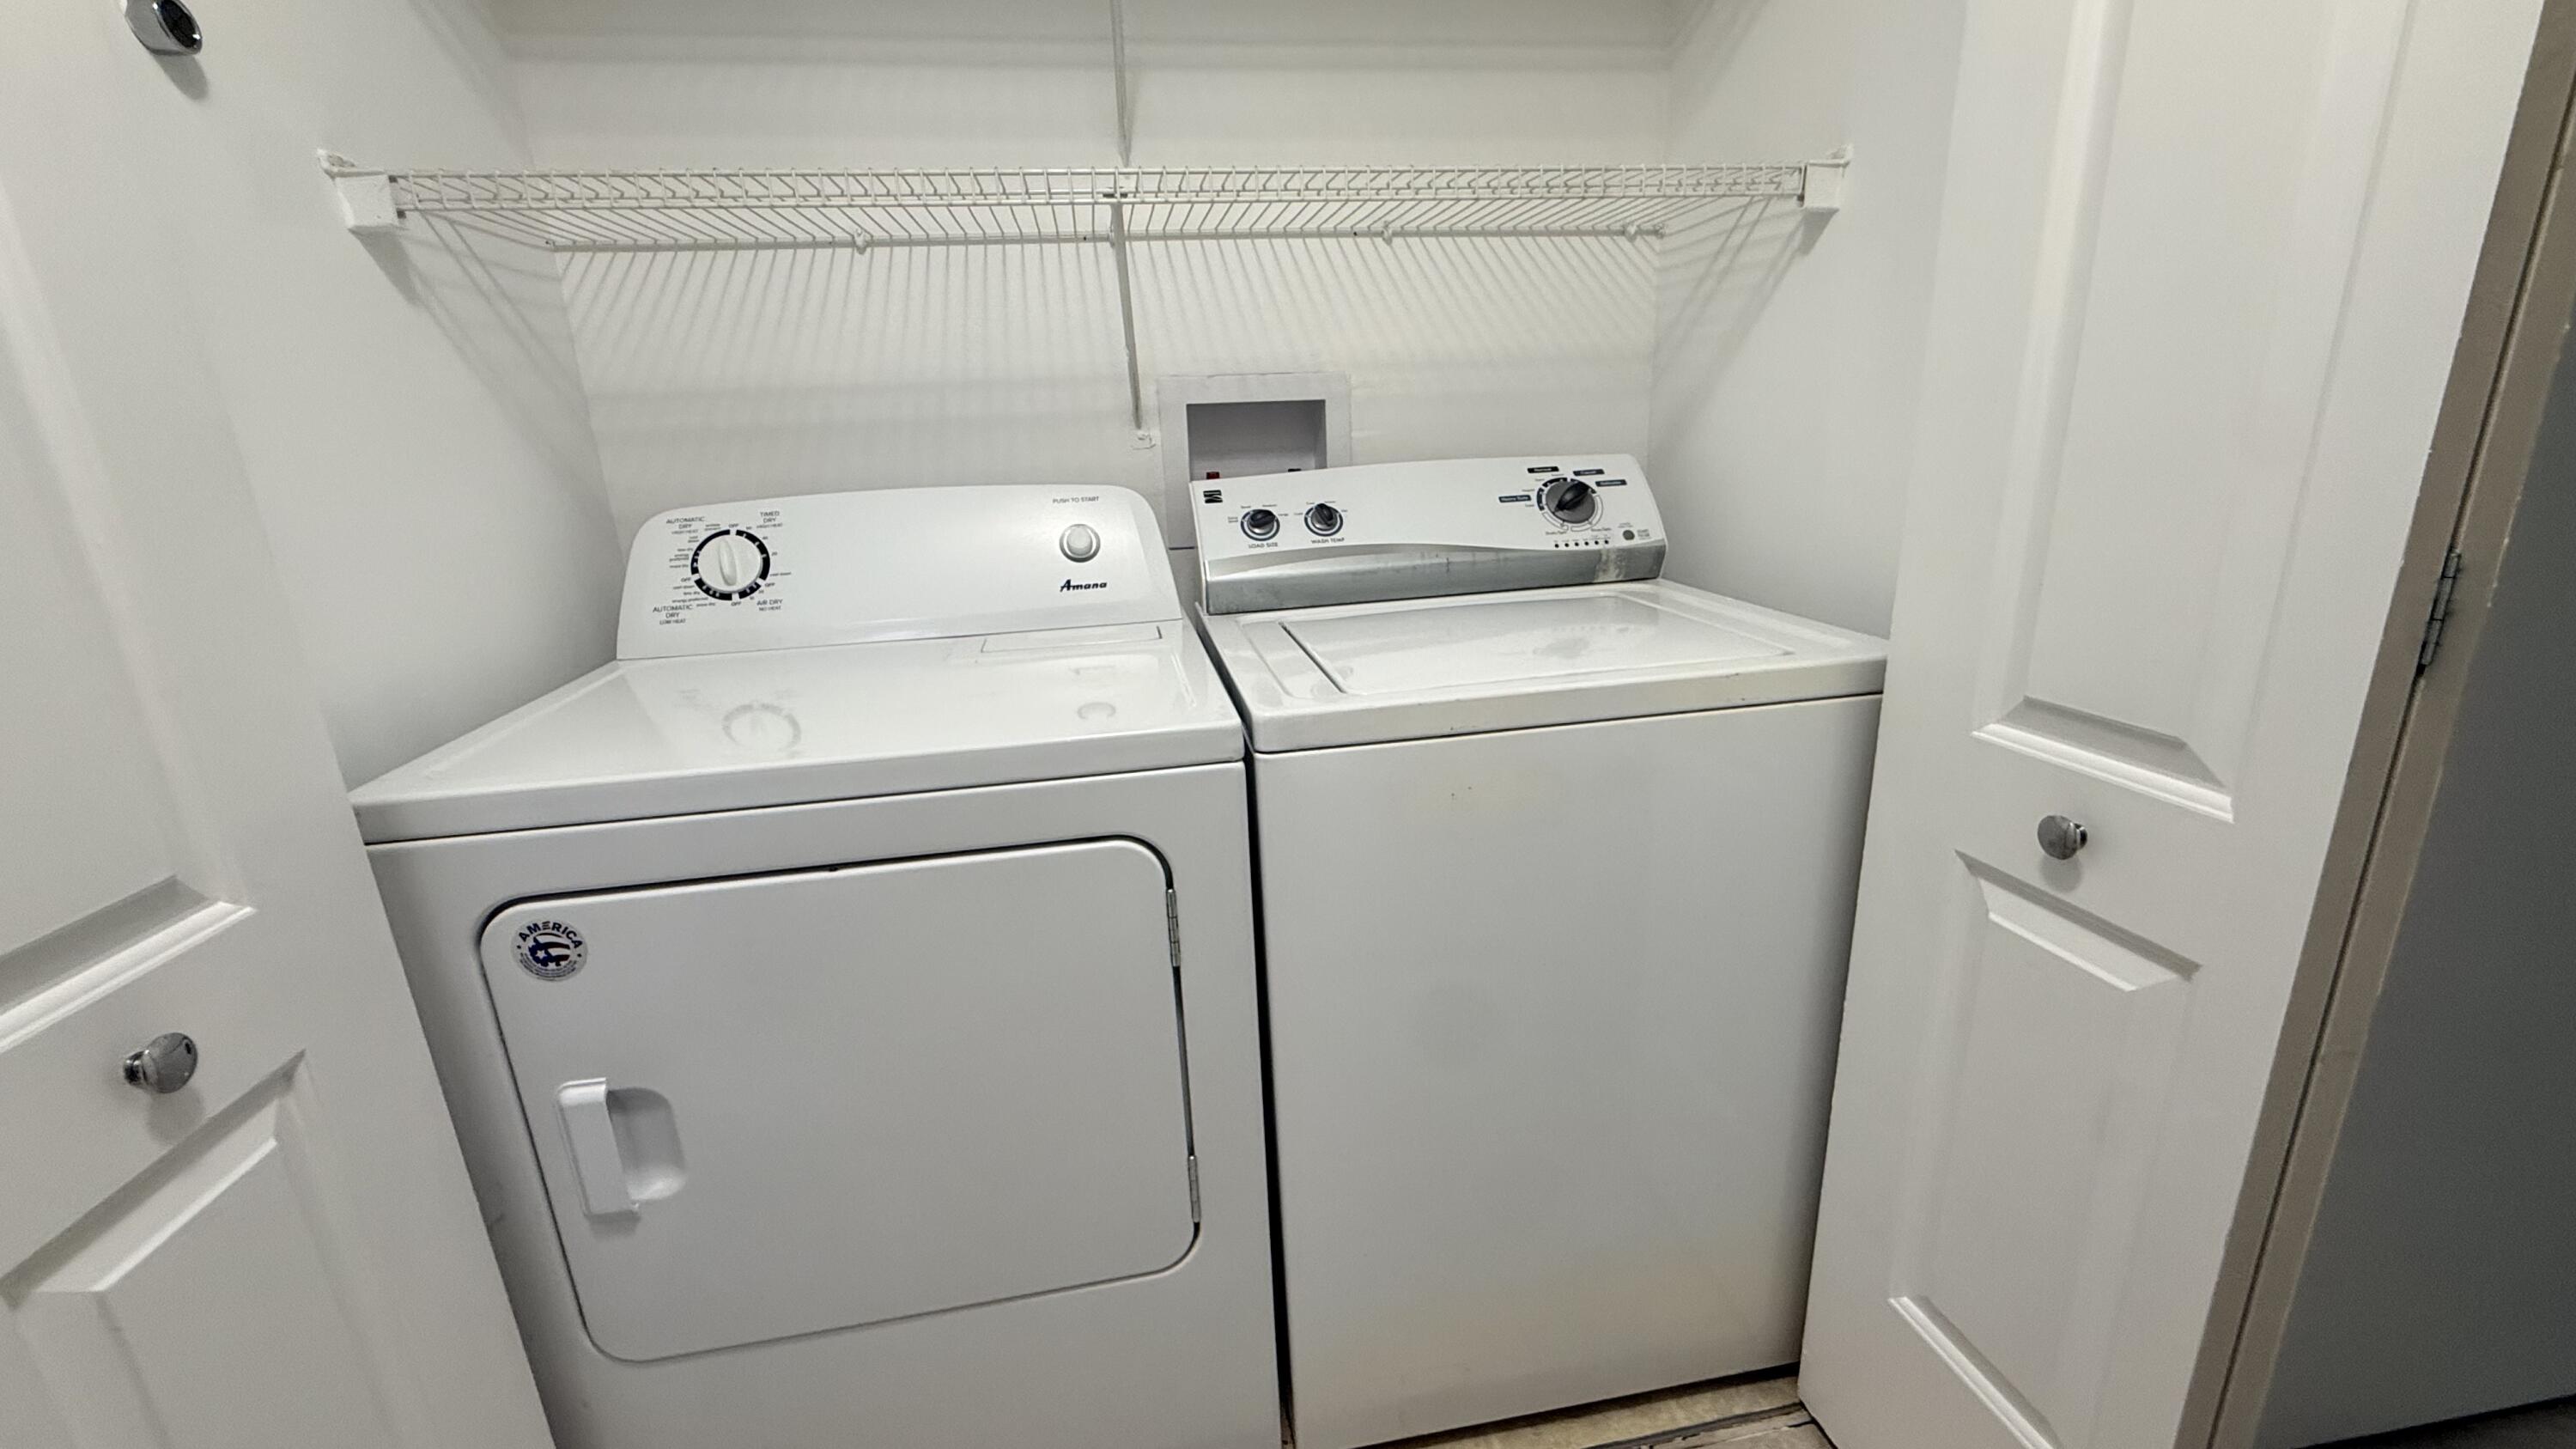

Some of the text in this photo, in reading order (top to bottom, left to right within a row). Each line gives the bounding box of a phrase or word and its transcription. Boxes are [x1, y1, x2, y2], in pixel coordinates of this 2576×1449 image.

[1060, 579, 1107, 593] Amana
[653, 604, 693, 612] AUTOMATIC
[519, 921, 583, 949] AMERICA
